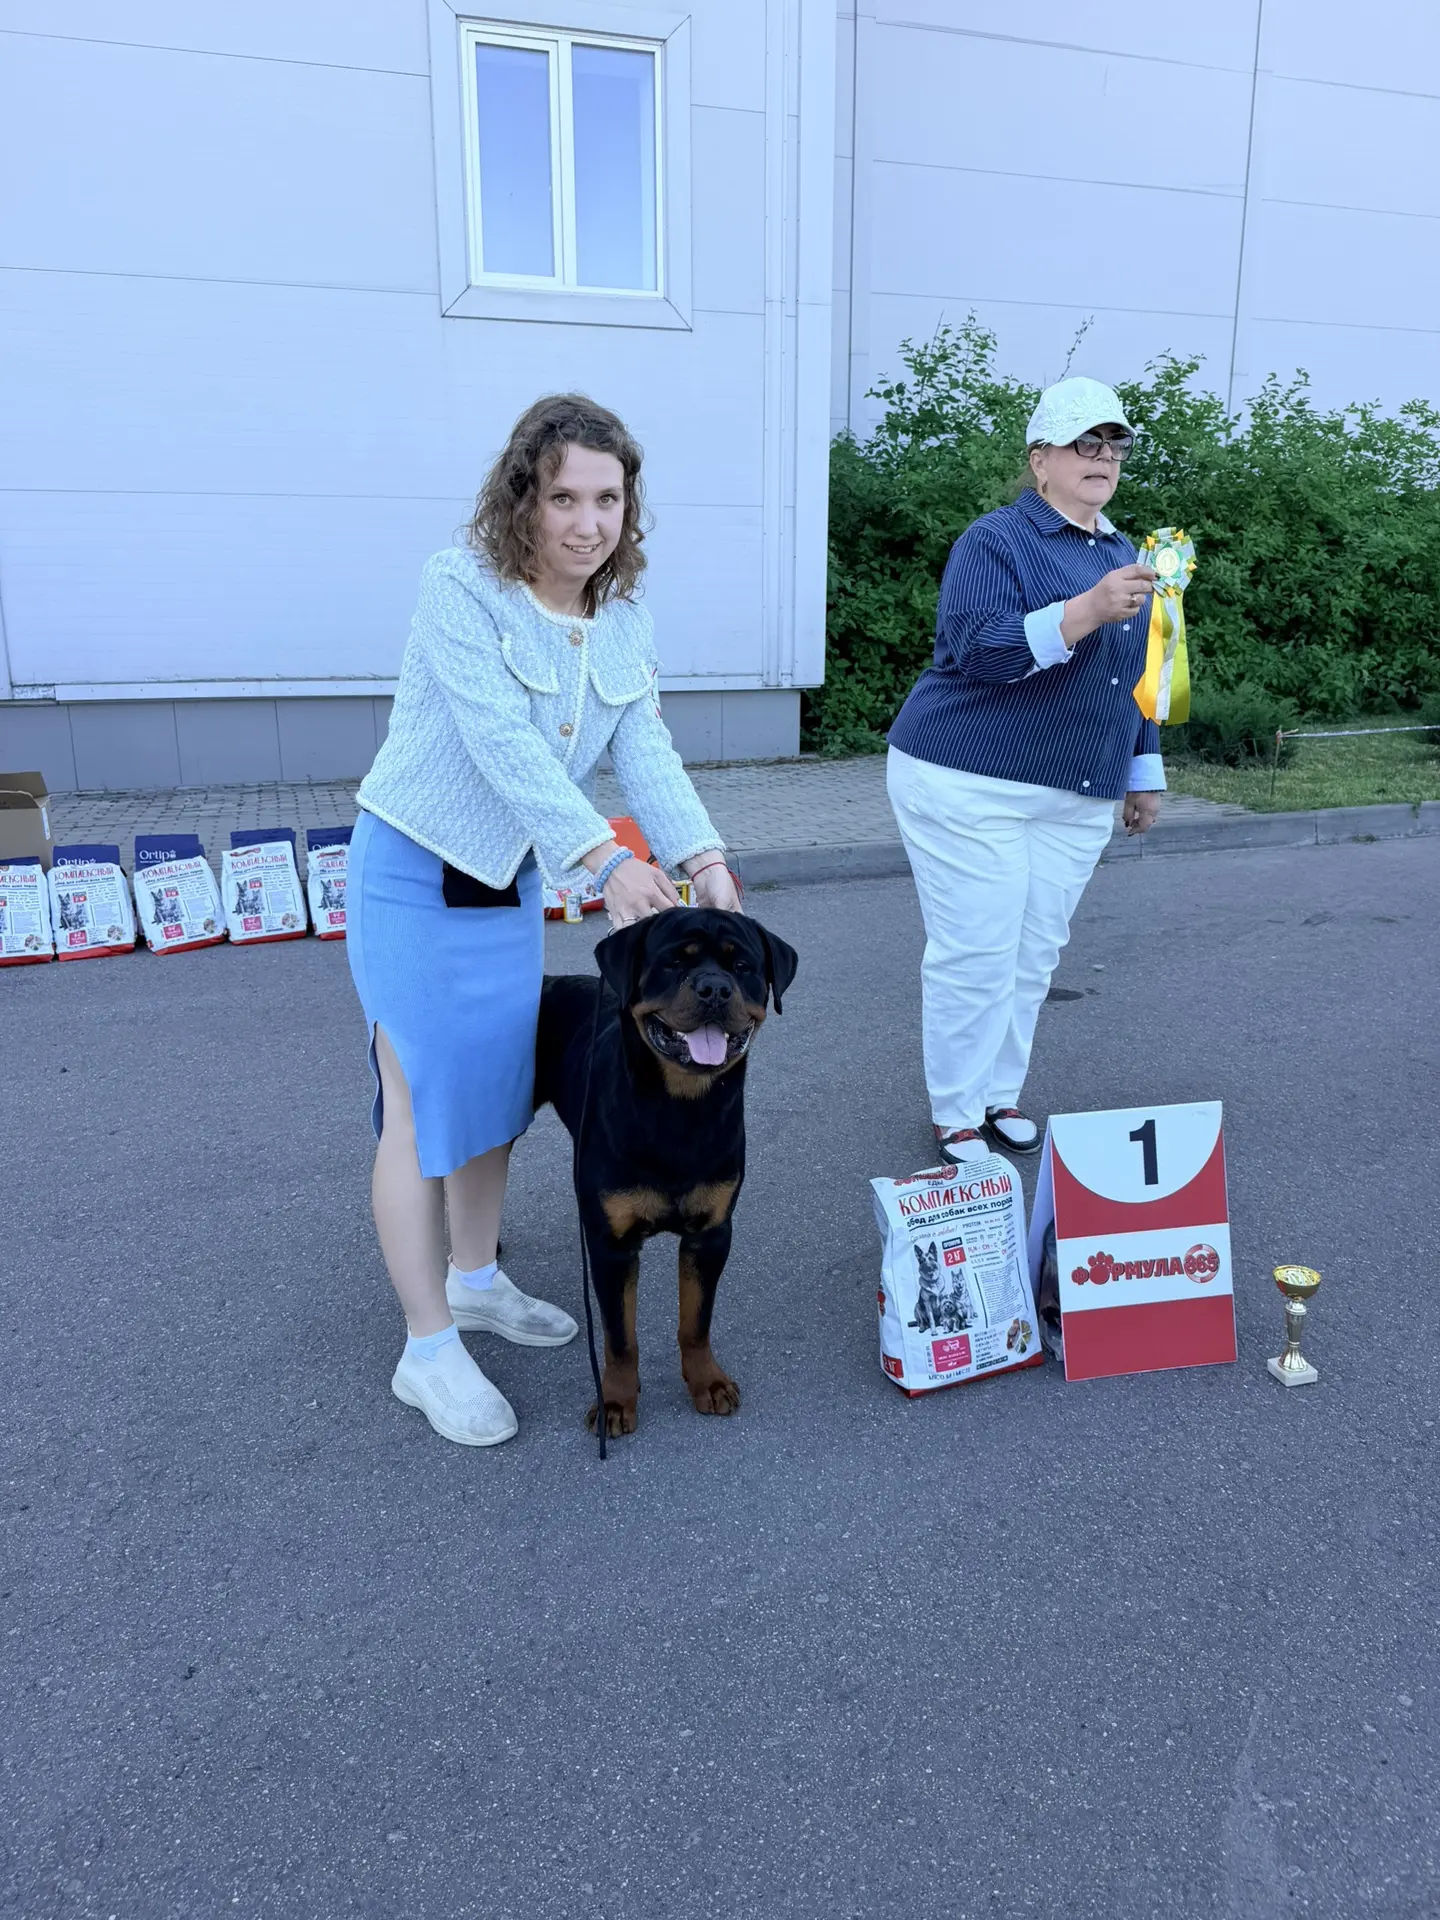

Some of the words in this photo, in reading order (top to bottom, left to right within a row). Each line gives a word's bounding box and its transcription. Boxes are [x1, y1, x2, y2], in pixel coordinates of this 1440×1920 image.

[1129, 1119, 1159, 1186] 1
[898, 1172, 1013, 1217] КОМПЛЕКСНЫЙ
[906, 1216, 927, 1228] обед
[928, 1213, 940, 1223] для
[941, 1208, 965, 1219] собак
[967, 1203, 989, 1213] всех
